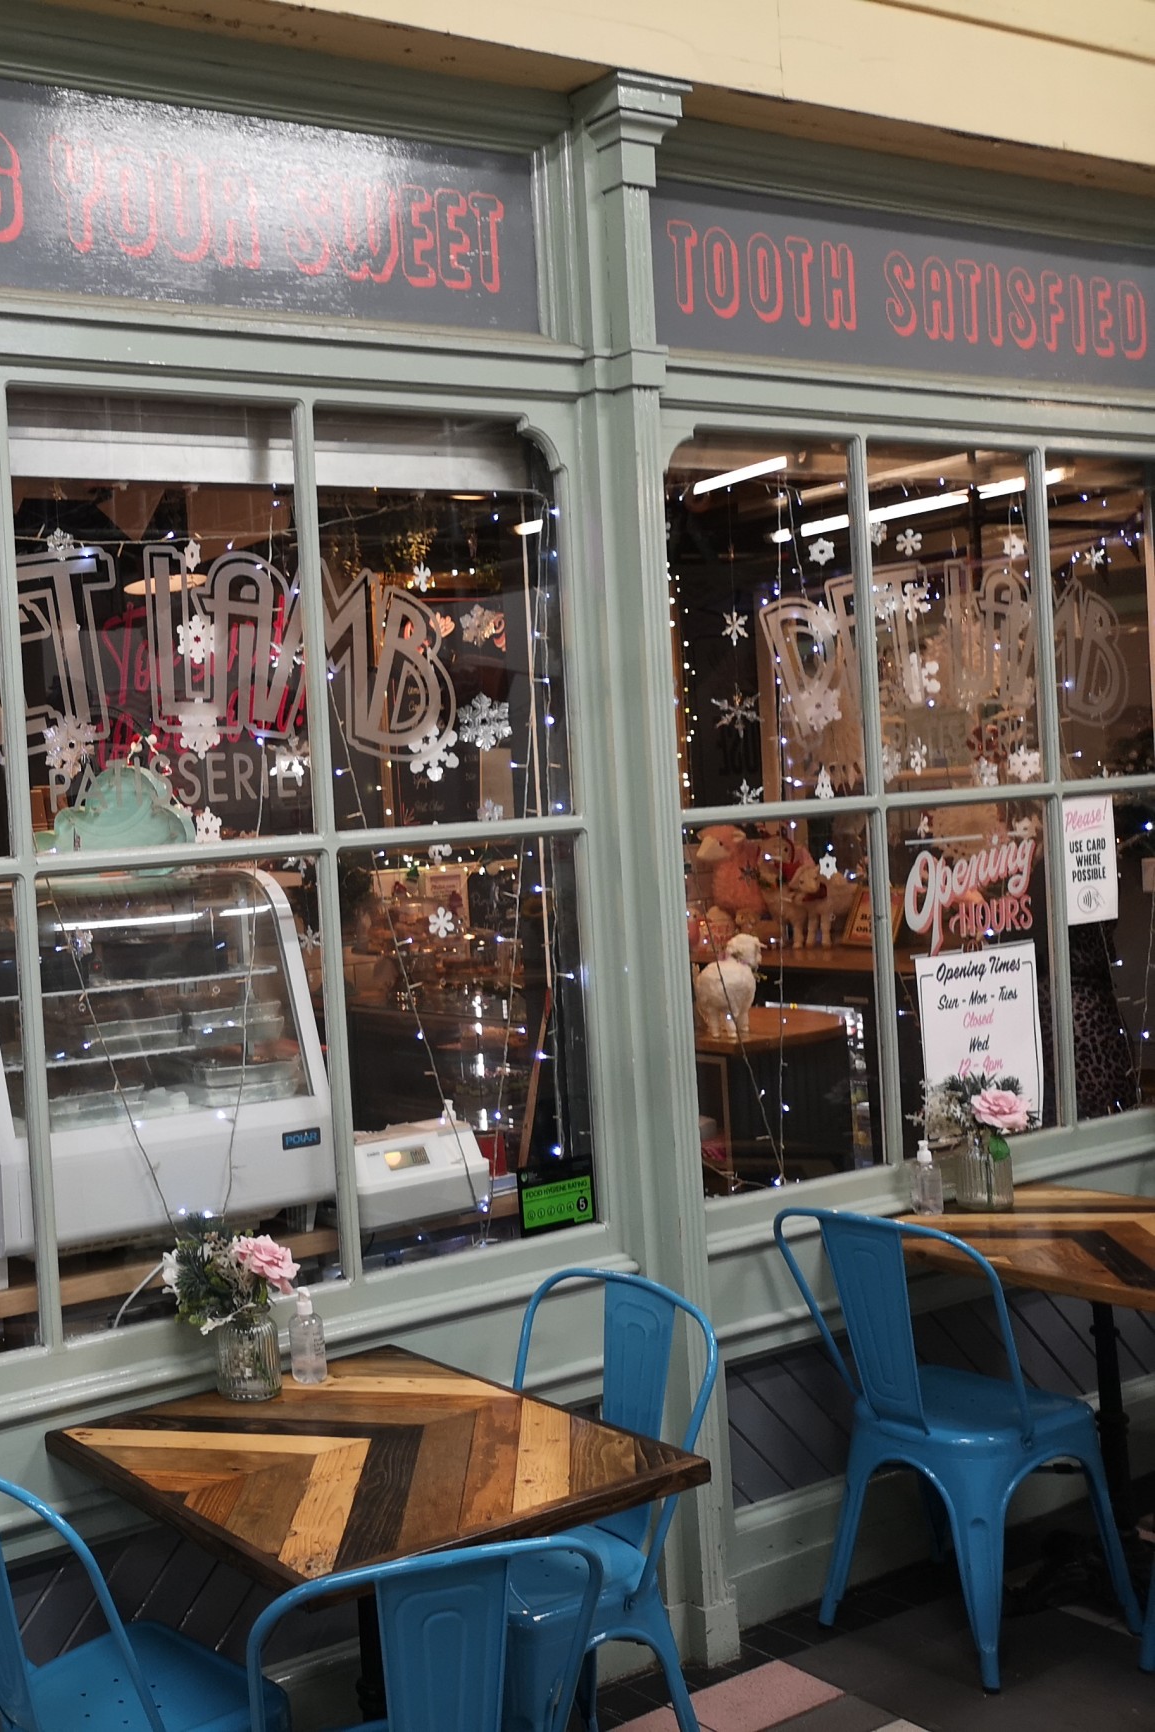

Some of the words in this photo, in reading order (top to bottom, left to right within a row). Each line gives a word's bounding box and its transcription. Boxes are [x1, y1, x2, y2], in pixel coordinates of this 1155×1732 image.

[48, 133, 261, 270] YOUR
[279, 165, 506, 294] SWEET
[666, 219, 857, 331] TOOTH
[882, 249, 1147, 361] SATISFIED
[143, 544, 456, 764] LAMB
[48, 751, 298, 813] PATISSERIE
[1064, 798, 1108, 833] Please!
[1069, 839, 1084, 854] USE
[1086, 837, 1107, 852] CARD
[1075, 852, 1102, 868] WHERE
[1071, 866, 1107, 883] POSSIBLE
[904, 837, 1038, 957] Opening
[949, 893, 1034, 939] HOURS
[935, 960, 987, 986] Opening
[989, 955, 1021, 975] Times
[937, 994, 960, 1011] Sun
[968, 989, 988, 1007] Mon
[998, 985, 1018, 1002] Tues
[962, 1008, 995, 1029] Closed
[968, 1034, 990, 1054] Wed
[958, 1057, 972, 1078] 12
[285, 1131, 318, 1146] POLAR
[579, 1197, 586, 1211] 5
